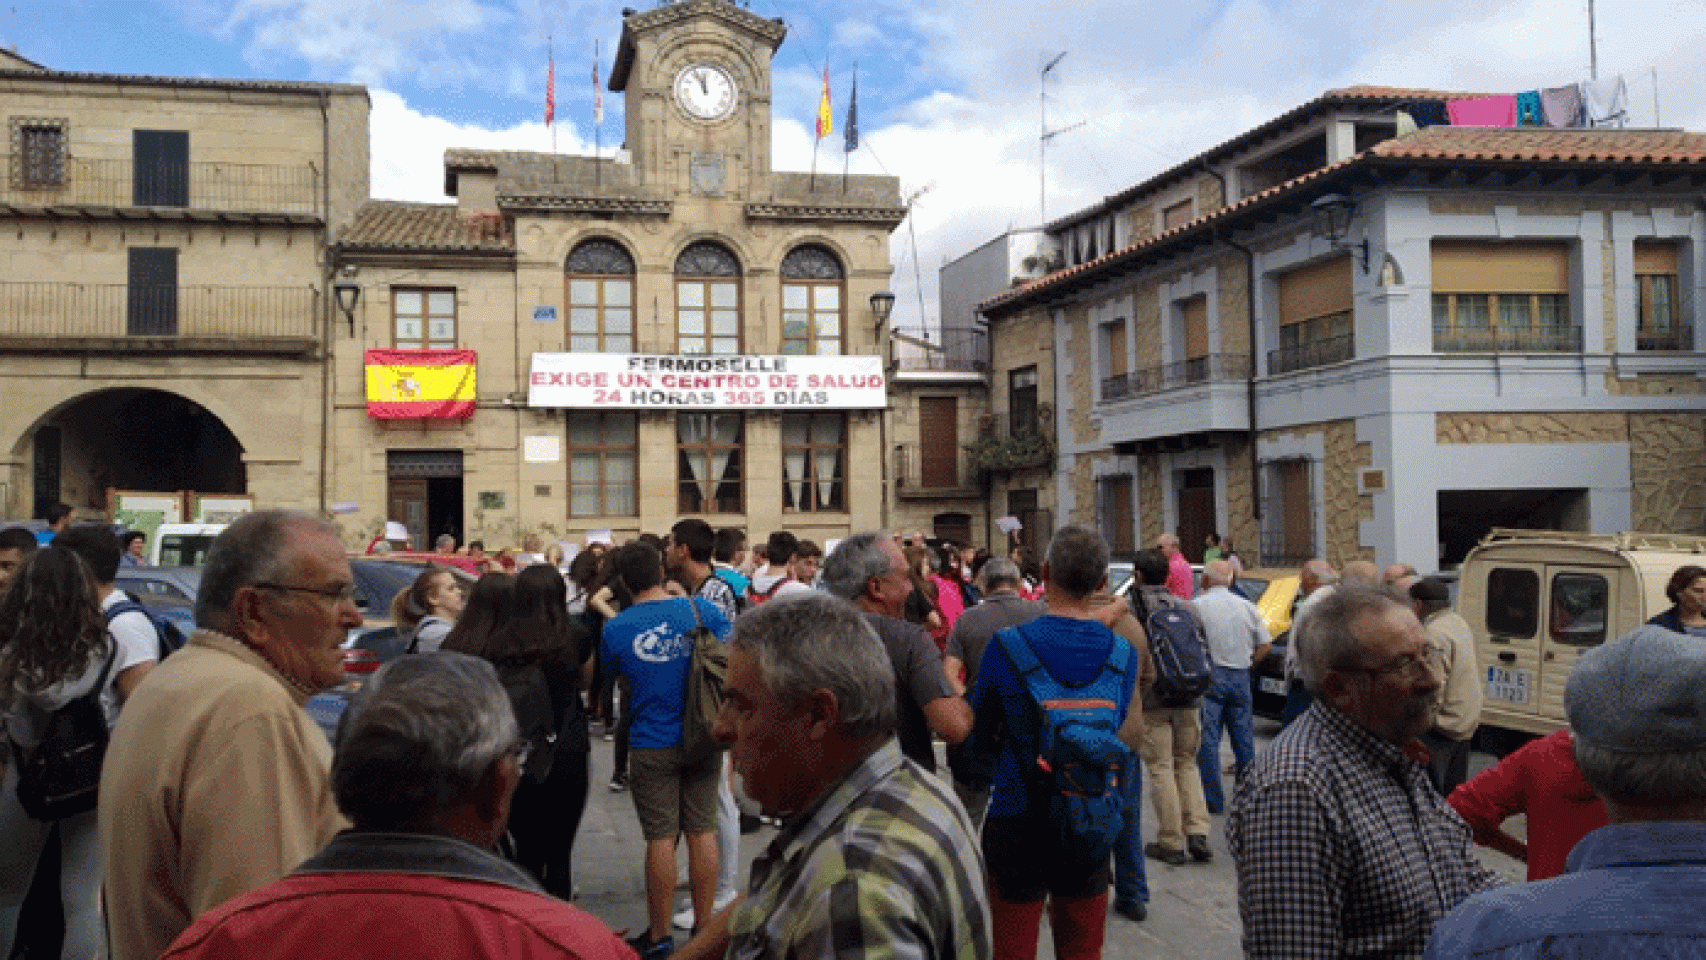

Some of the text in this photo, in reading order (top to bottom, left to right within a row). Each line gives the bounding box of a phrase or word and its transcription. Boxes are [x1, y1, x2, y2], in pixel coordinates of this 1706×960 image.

[628, 357, 787, 372] FERMOSELLE
[531, 372, 883, 389] EXIGE UN CENTRO DE SALUD
[593, 389, 621, 403] 24
[630, 390, 716, 404] HORAS
[723, 391, 765, 405] 365
